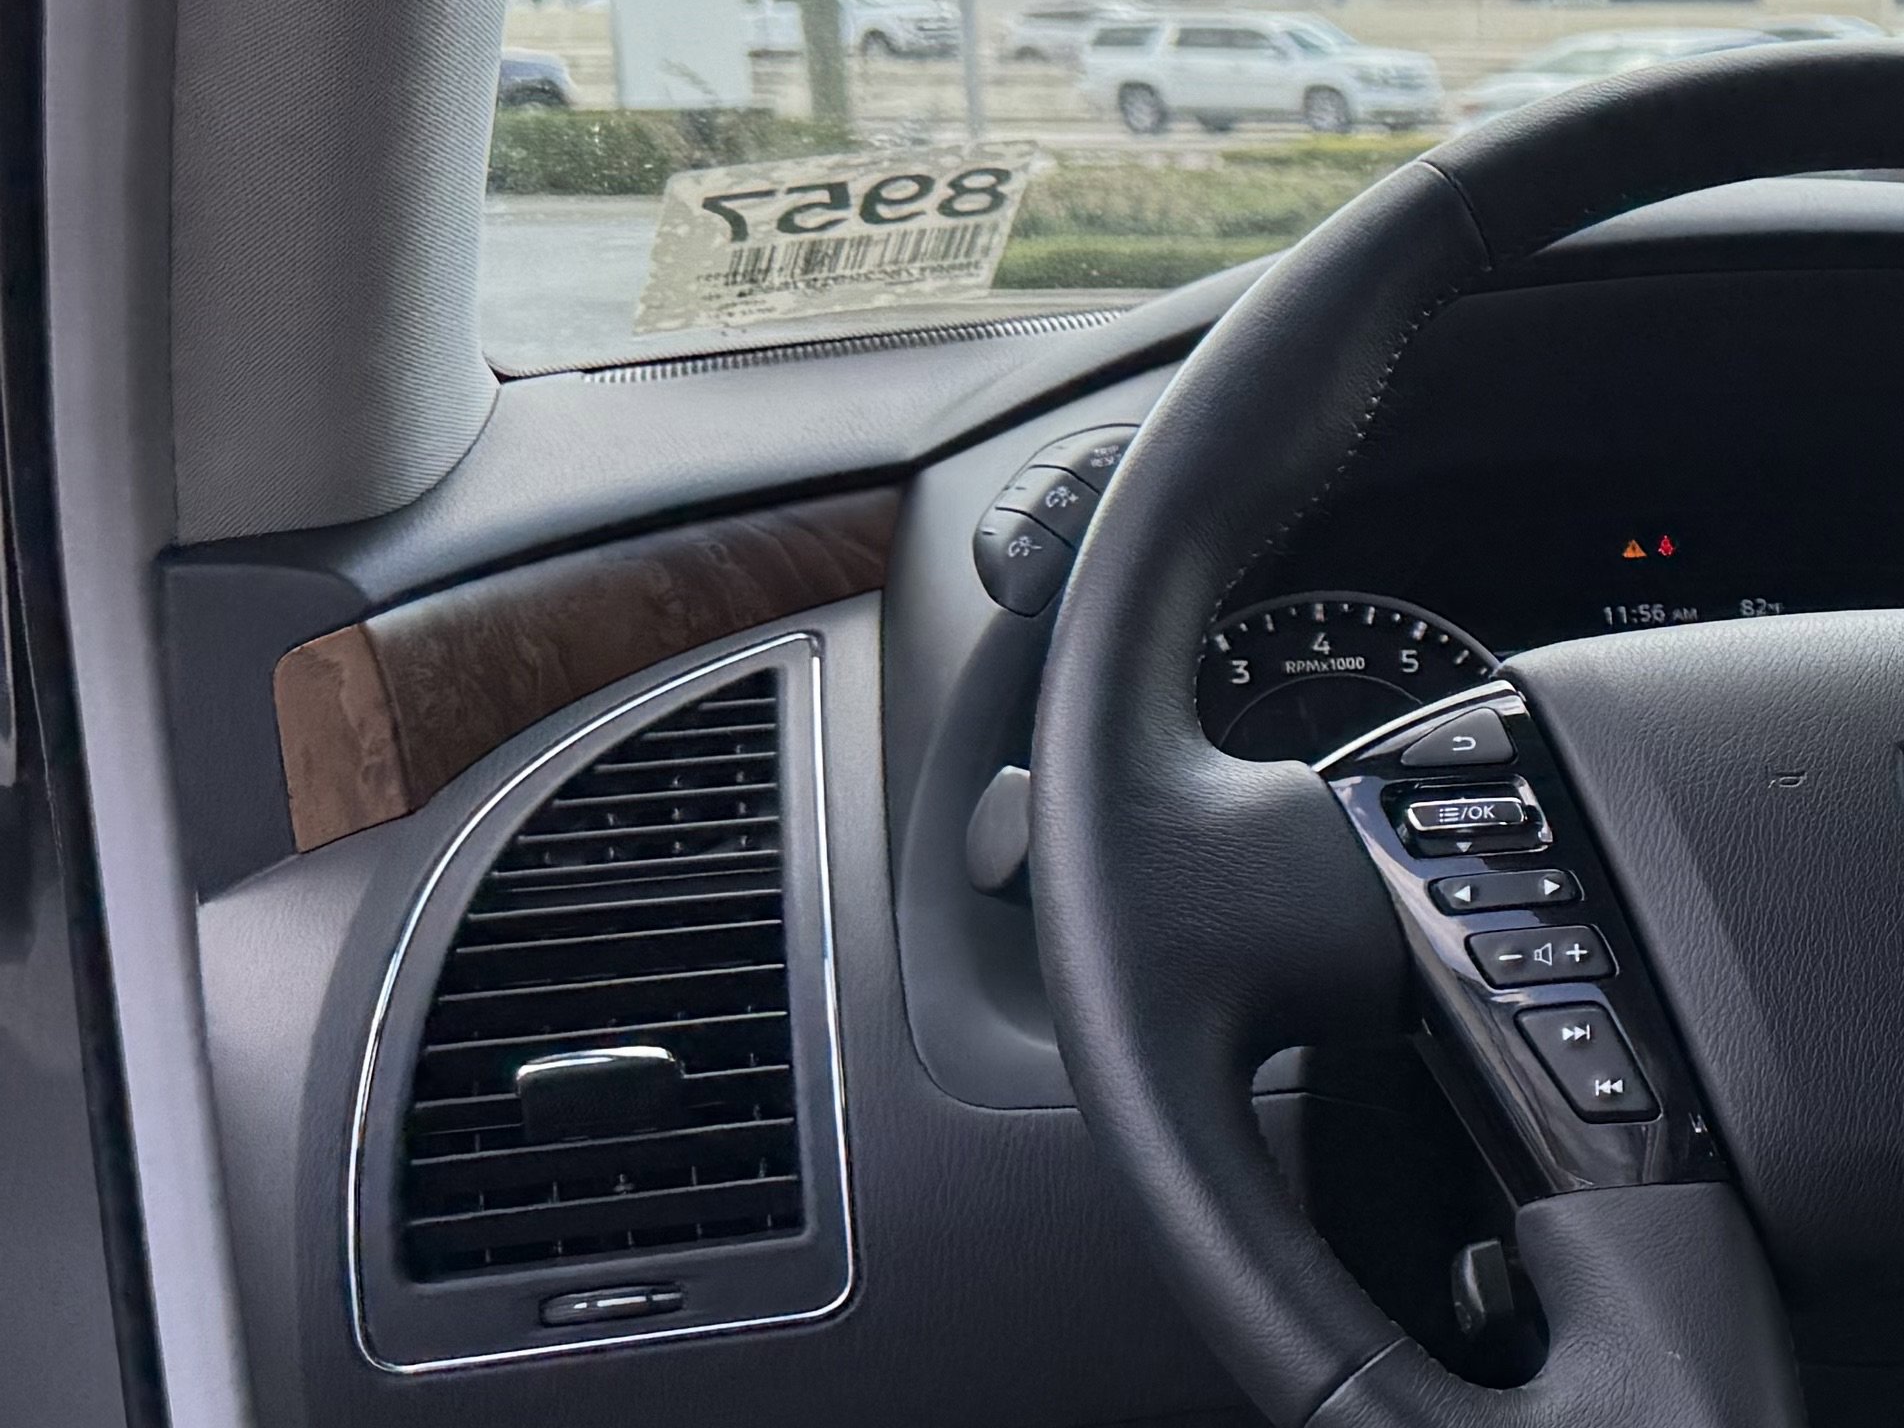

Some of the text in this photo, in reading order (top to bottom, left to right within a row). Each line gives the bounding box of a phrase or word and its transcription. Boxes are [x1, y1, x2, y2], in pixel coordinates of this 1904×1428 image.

[1603, 604, 1698, 626] 11:56 AM
[1312, 632, 1331, 655] 4
[1230, 659, 1251, 684] 3
[1286, 656, 1366, 674] RPMx1000
[1400, 649, 1419, 673] 5
